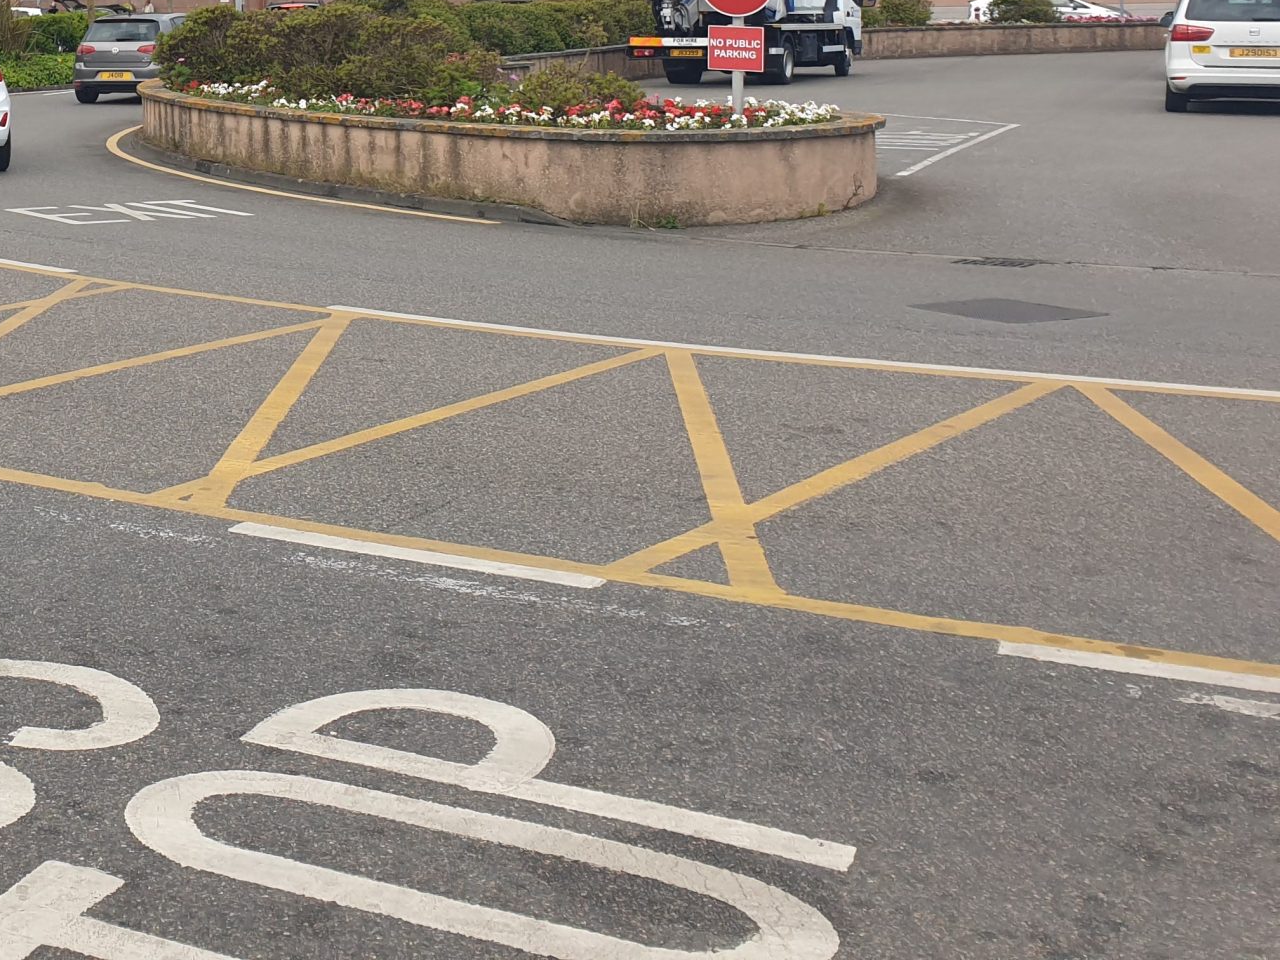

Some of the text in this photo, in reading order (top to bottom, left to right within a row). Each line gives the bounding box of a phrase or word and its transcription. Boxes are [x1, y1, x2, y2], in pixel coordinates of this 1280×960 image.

[709, 38, 761, 48] NO PUBLIC
[714, 50, 756, 59] PARKING
[3, 200, 255, 225] EXIT
